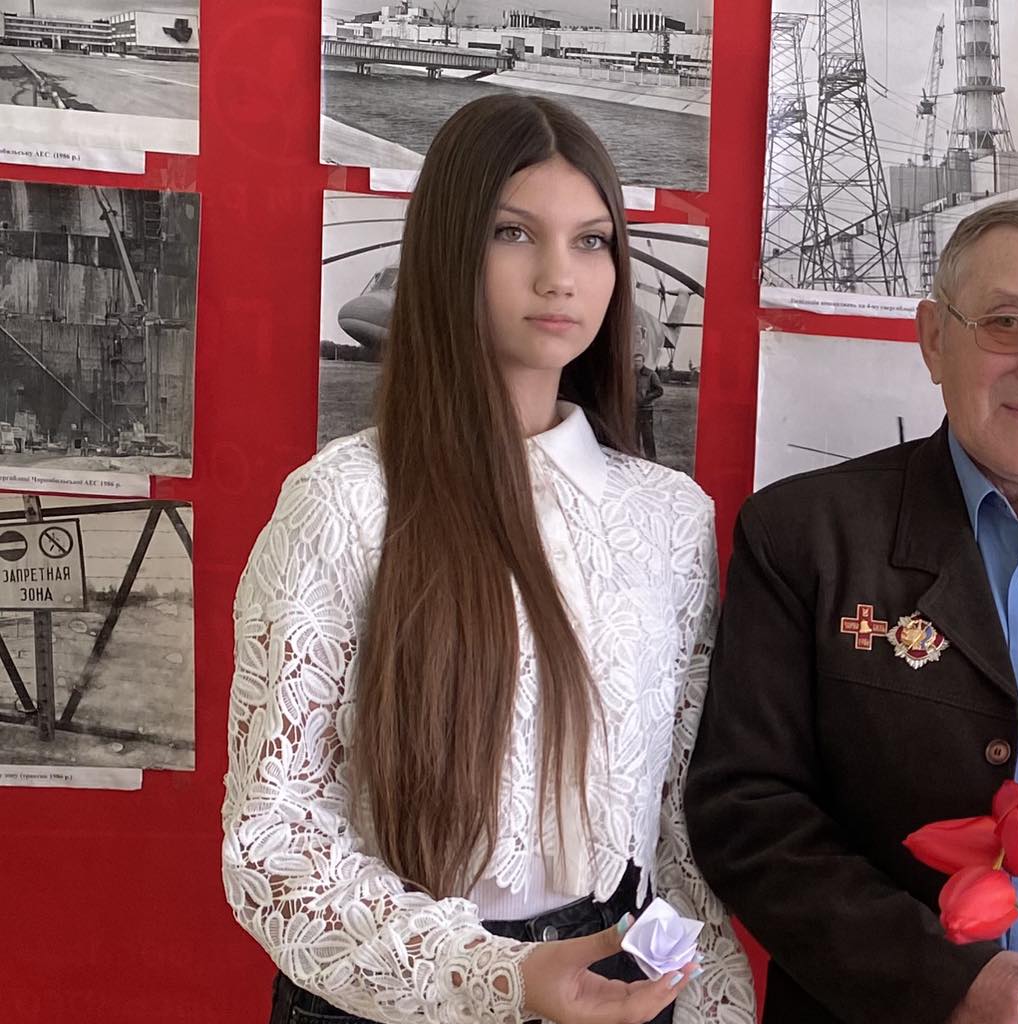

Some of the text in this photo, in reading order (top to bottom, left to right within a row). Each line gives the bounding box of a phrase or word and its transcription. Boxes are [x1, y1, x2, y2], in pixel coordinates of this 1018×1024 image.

[84, 480, 97, 488] АЕС
[2, 565, 71, 583] ЗАПРЕТНАЯ
[20, 587, 53, 602] ЗОНА
